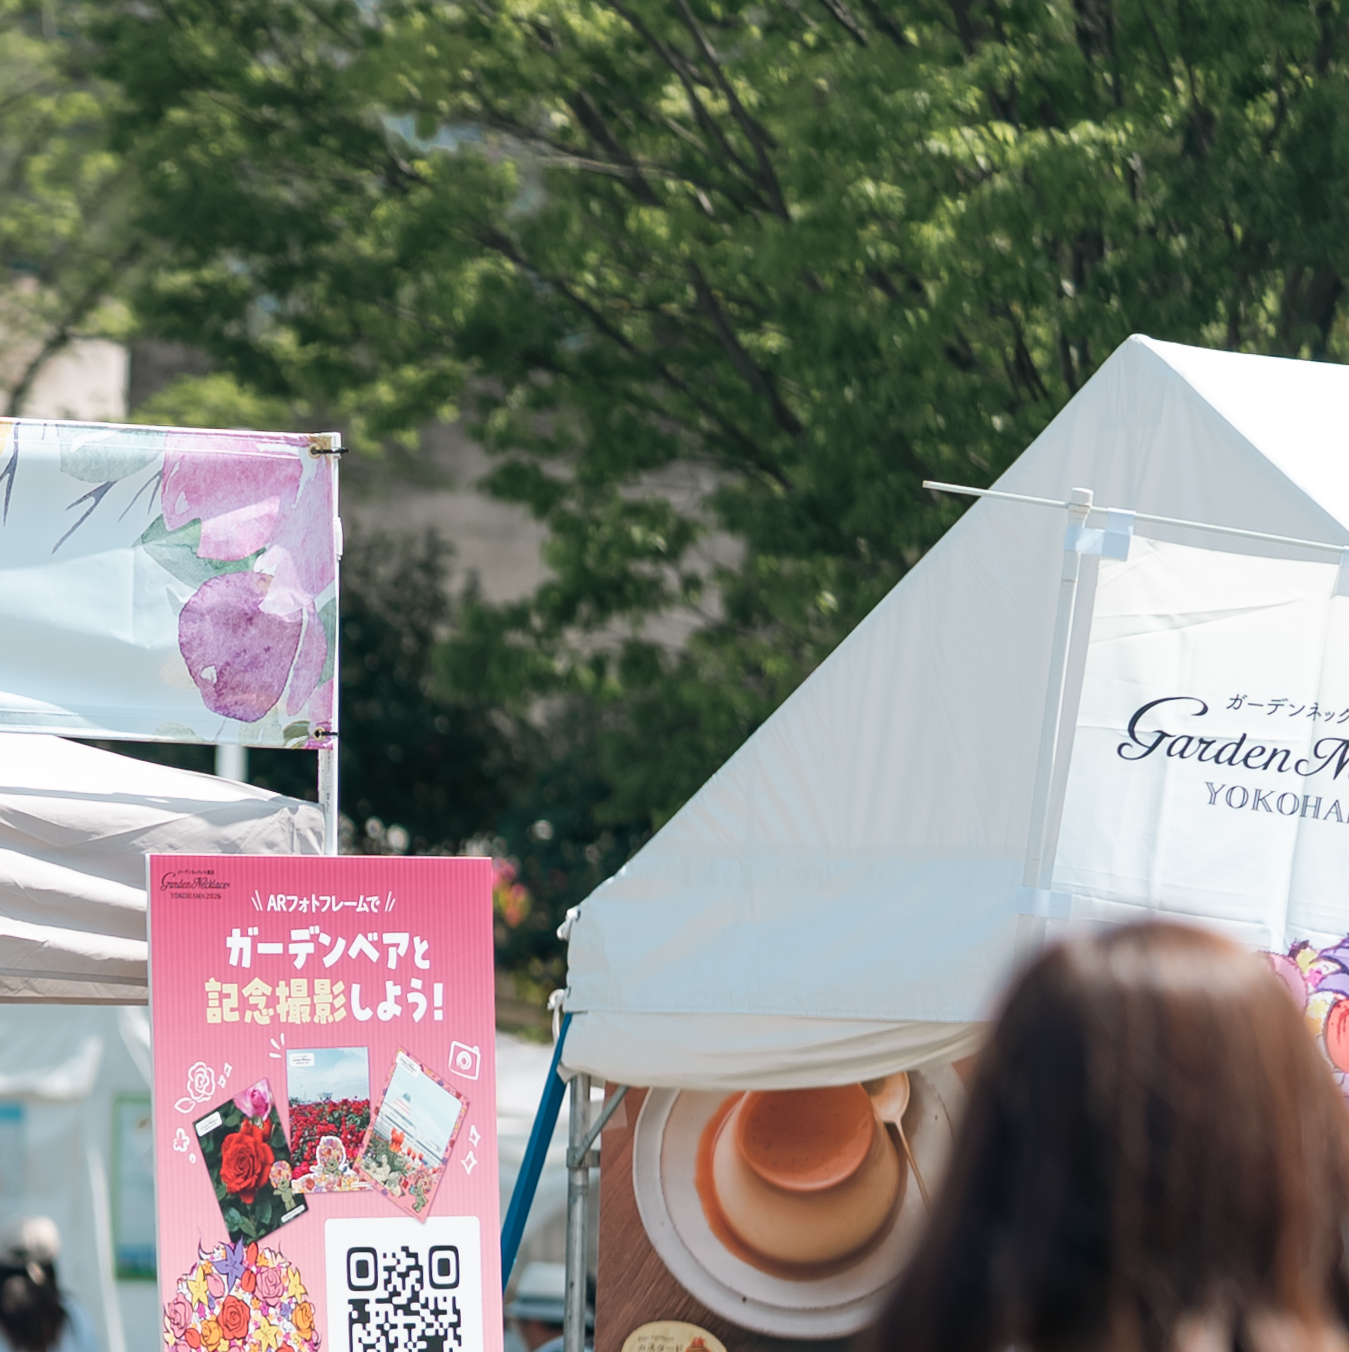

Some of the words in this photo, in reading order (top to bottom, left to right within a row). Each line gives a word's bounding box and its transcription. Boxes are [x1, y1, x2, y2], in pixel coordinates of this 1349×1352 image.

[1117, 696, 1292, 773] Garden
[1204, 781, 1349, 824] YOKOHA
[267, 894, 380, 913] ARフォトフレームで
[226, 925, 430, 970] ガーデンベアと
[205, 977, 444, 1025] 記念撮影しよう！
